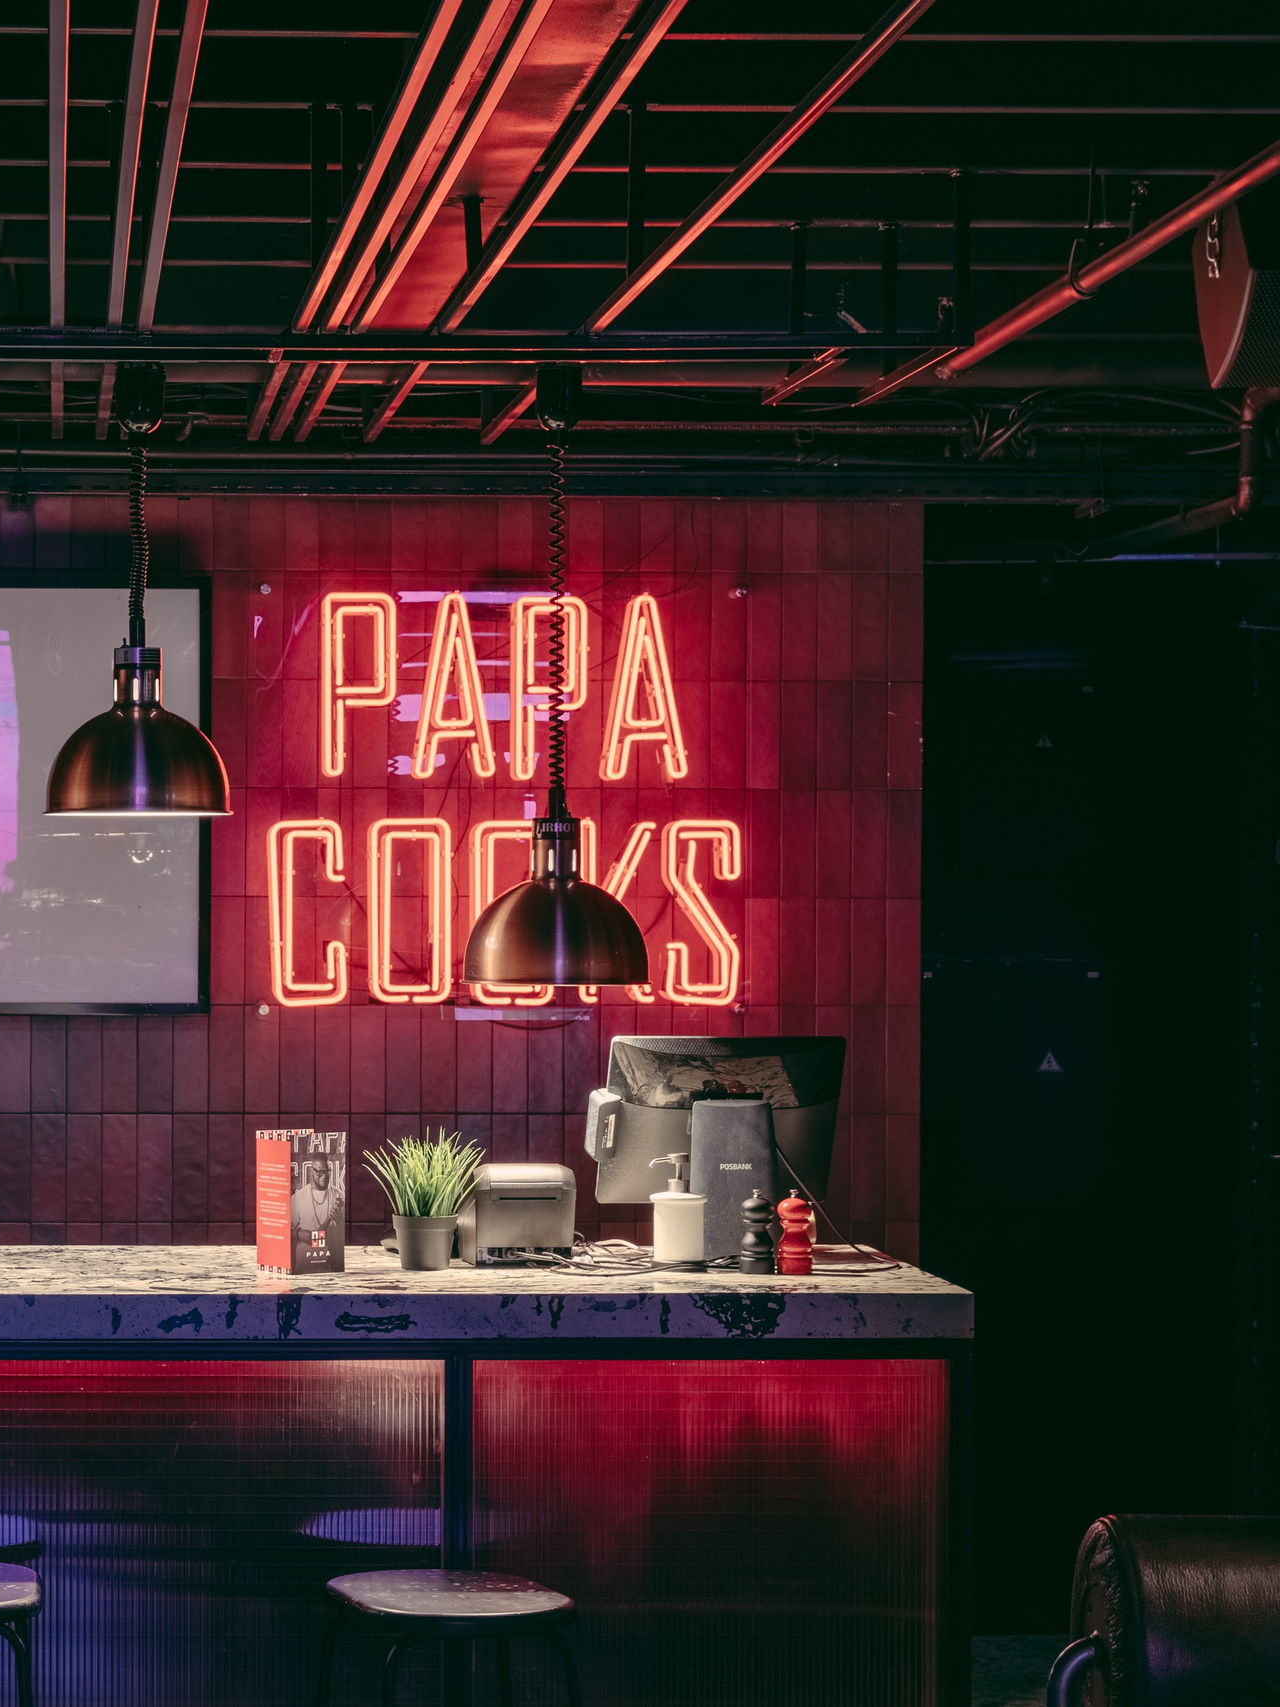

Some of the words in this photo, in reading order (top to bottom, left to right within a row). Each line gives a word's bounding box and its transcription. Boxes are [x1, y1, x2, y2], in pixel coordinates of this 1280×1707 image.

[322, 592, 688, 780] PAPA
[719, 1163, 752, 1171] POSBANK
[306, 1250, 331, 1258] PAPA
